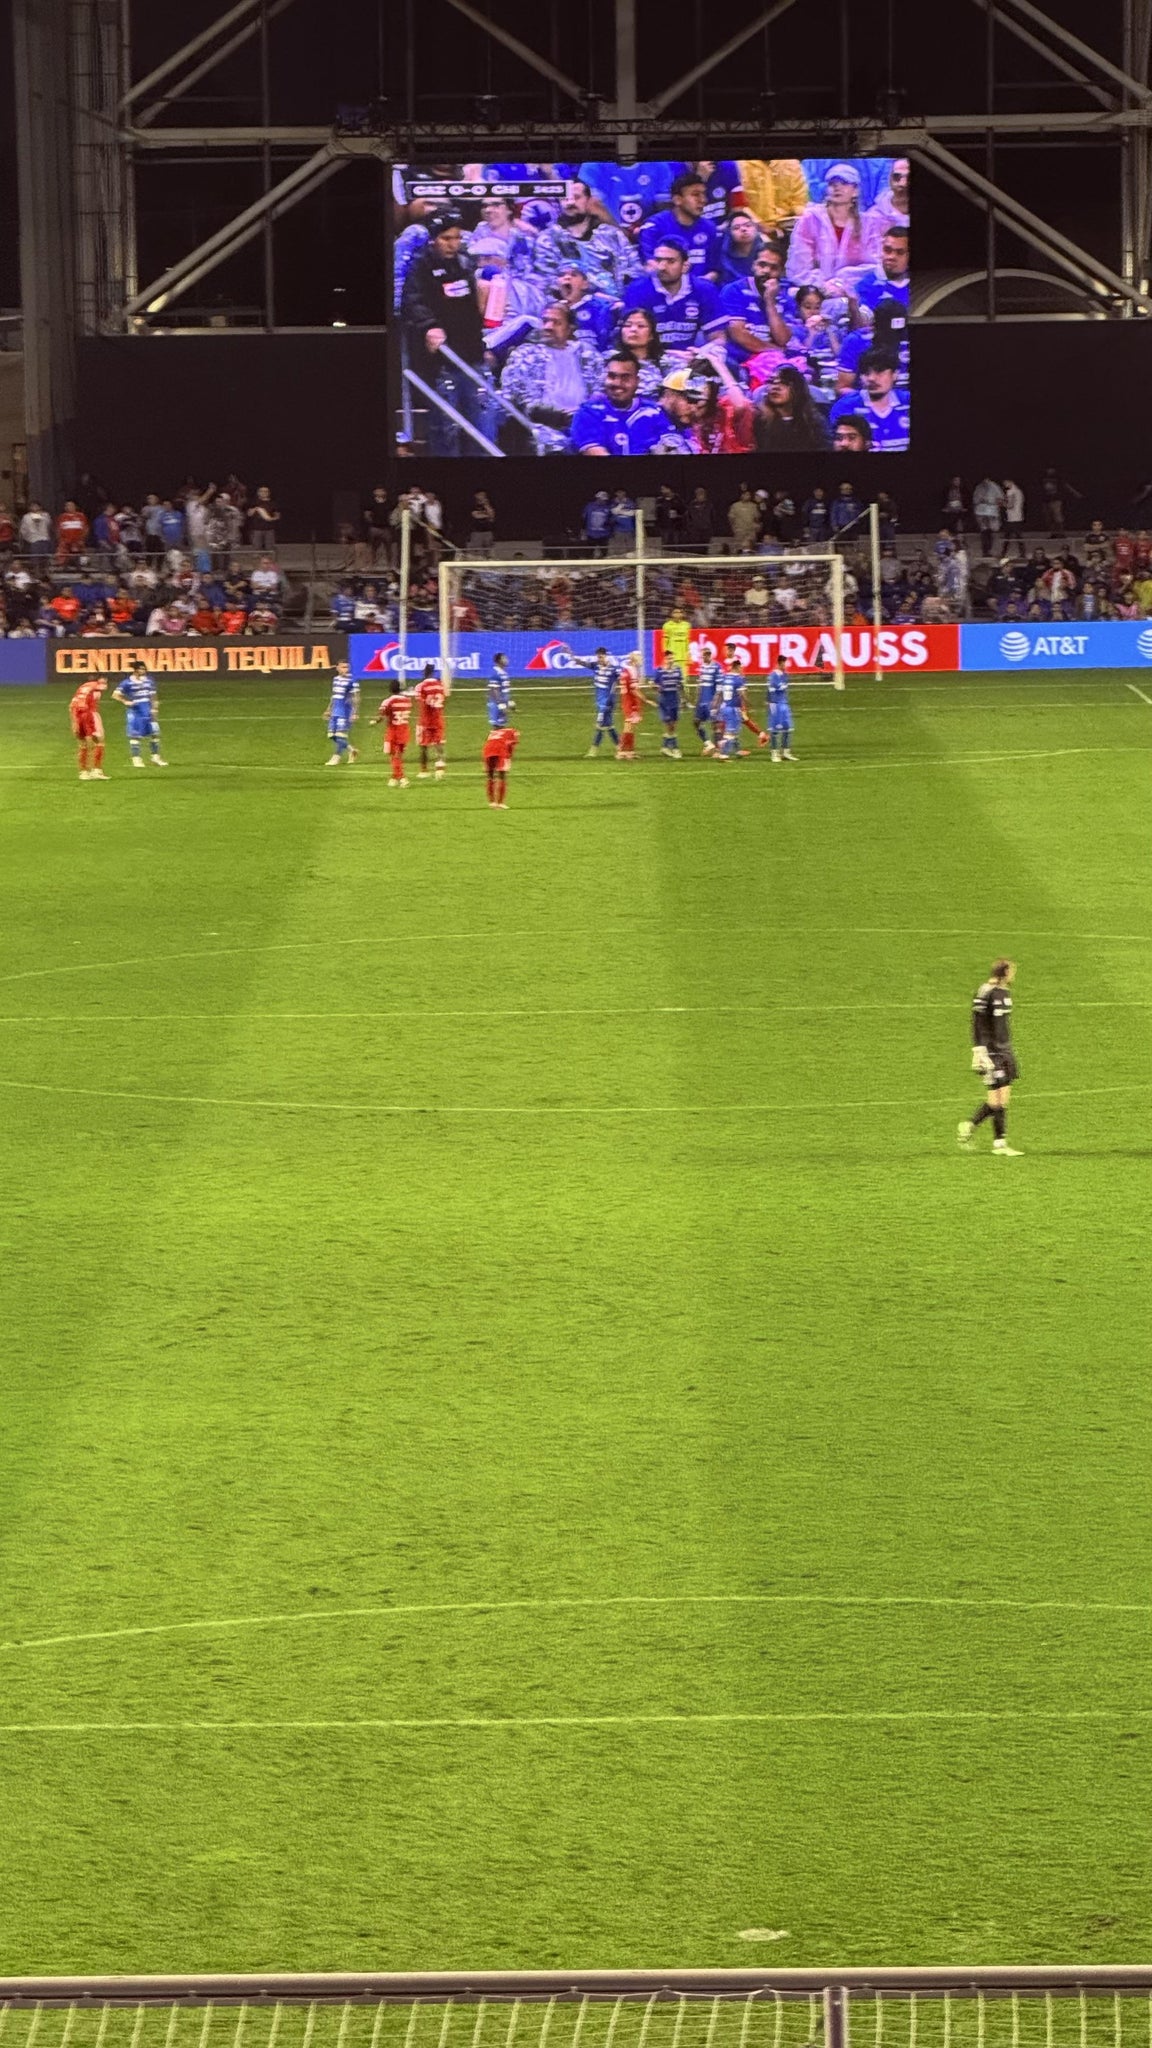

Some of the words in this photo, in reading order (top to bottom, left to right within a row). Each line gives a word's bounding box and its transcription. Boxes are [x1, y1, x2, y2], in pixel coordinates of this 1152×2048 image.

[723, 631, 929, 669] STRAUSS
[1032, 636, 1089, 655] AT&T
[55, 647, 218, 673] CENTENARIO
[223, 645, 331, 674] TEQUILA
[390, 652, 480, 671] Carnval
